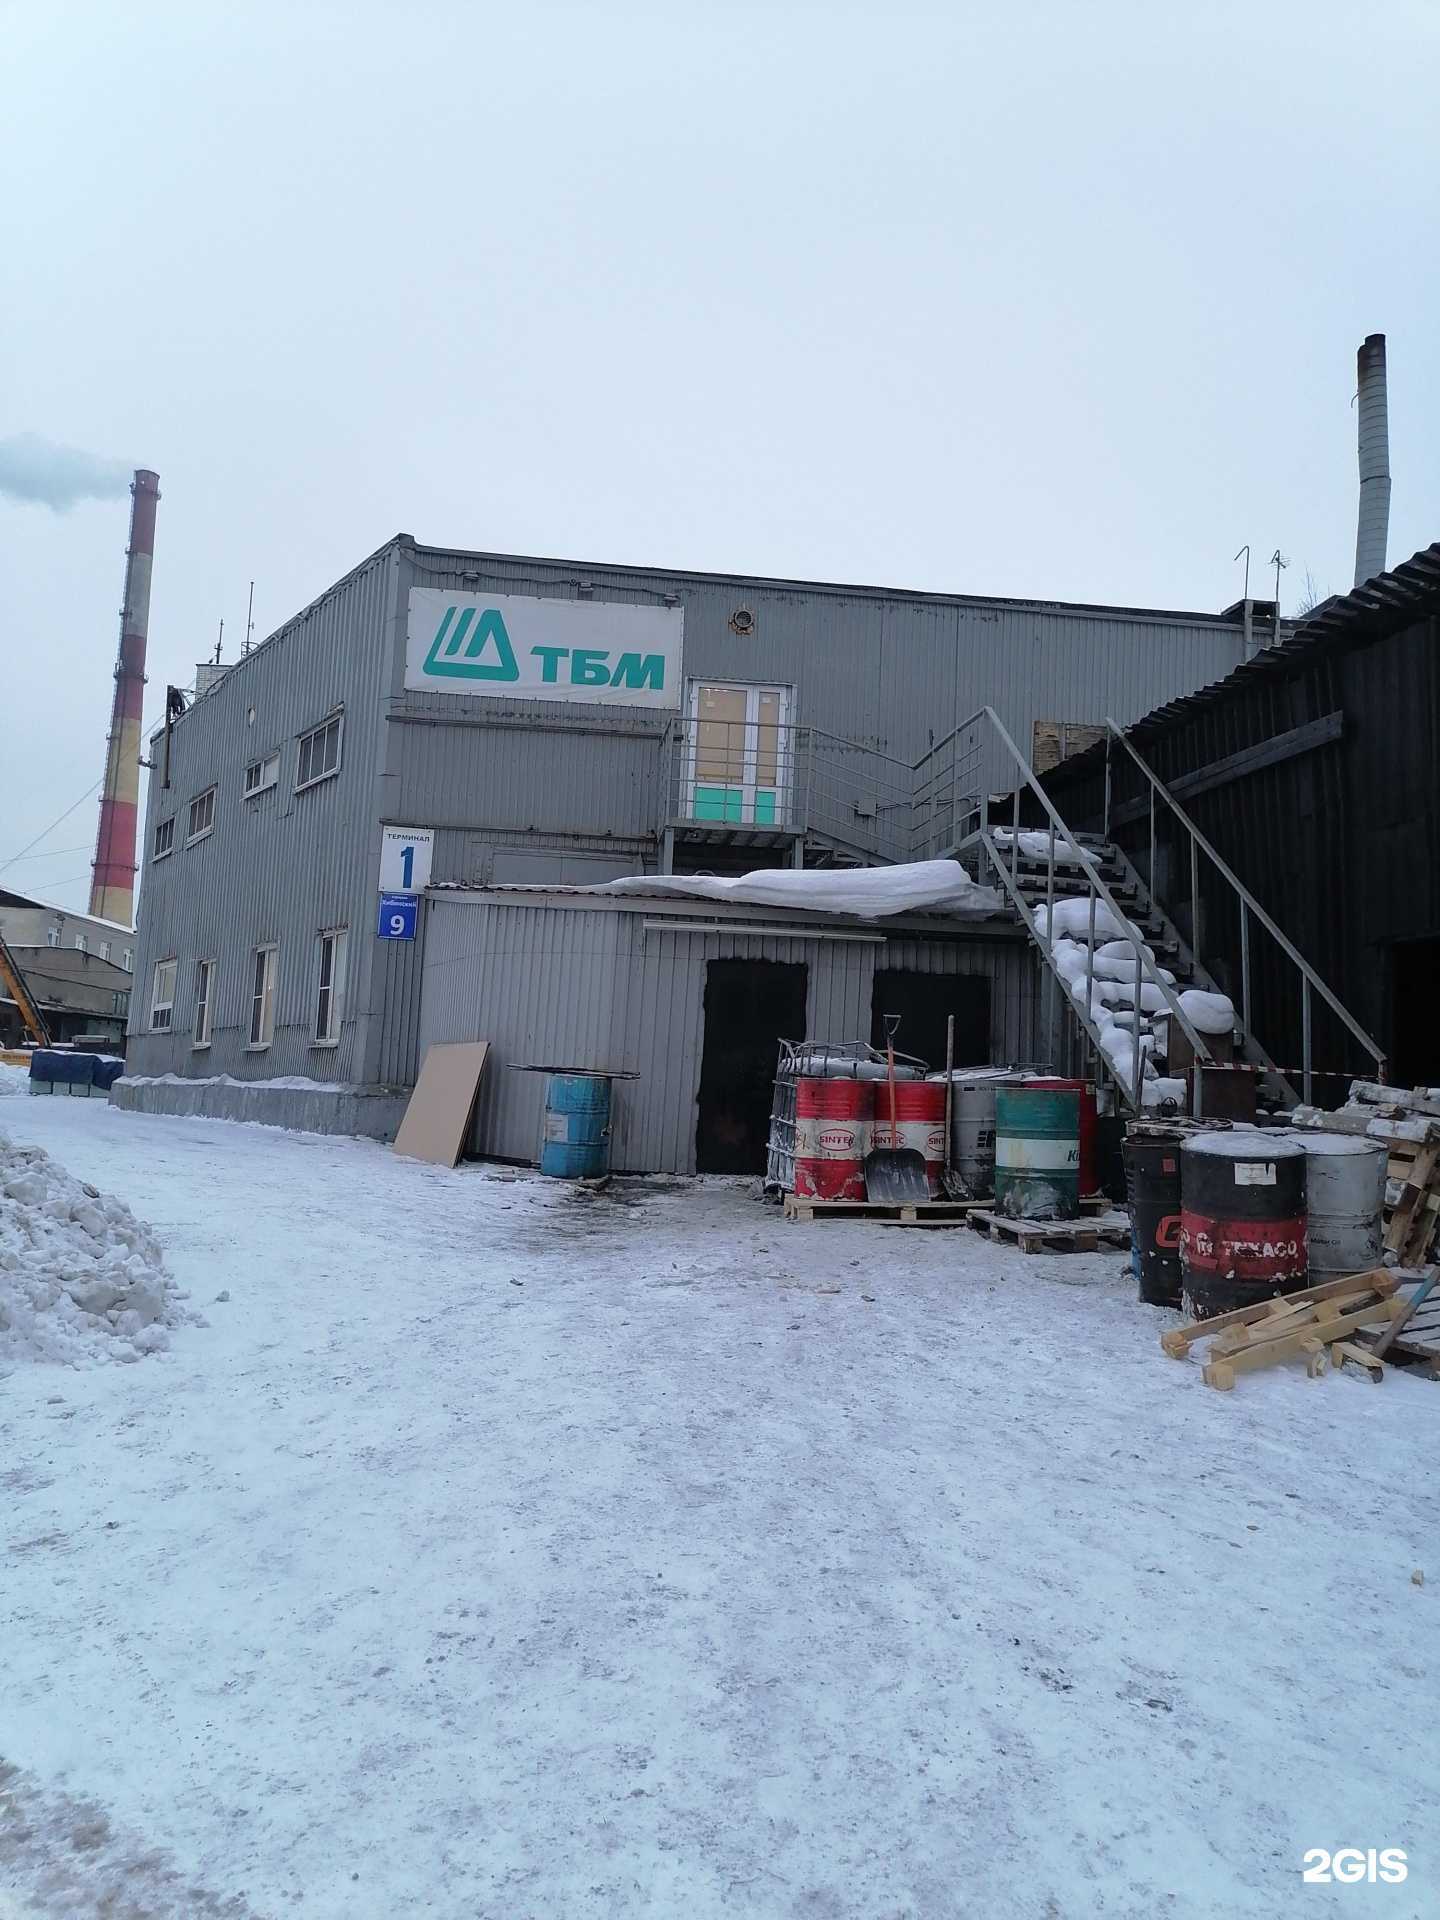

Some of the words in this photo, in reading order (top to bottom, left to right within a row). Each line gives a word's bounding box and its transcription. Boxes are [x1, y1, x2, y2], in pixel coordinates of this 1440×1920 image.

[531, 646, 665, 690] ТБМ
[386, 833, 430, 842] ТЕРМИНАЛ
[400, 846, 414, 888] 1
[390, 914, 404, 935] 9
